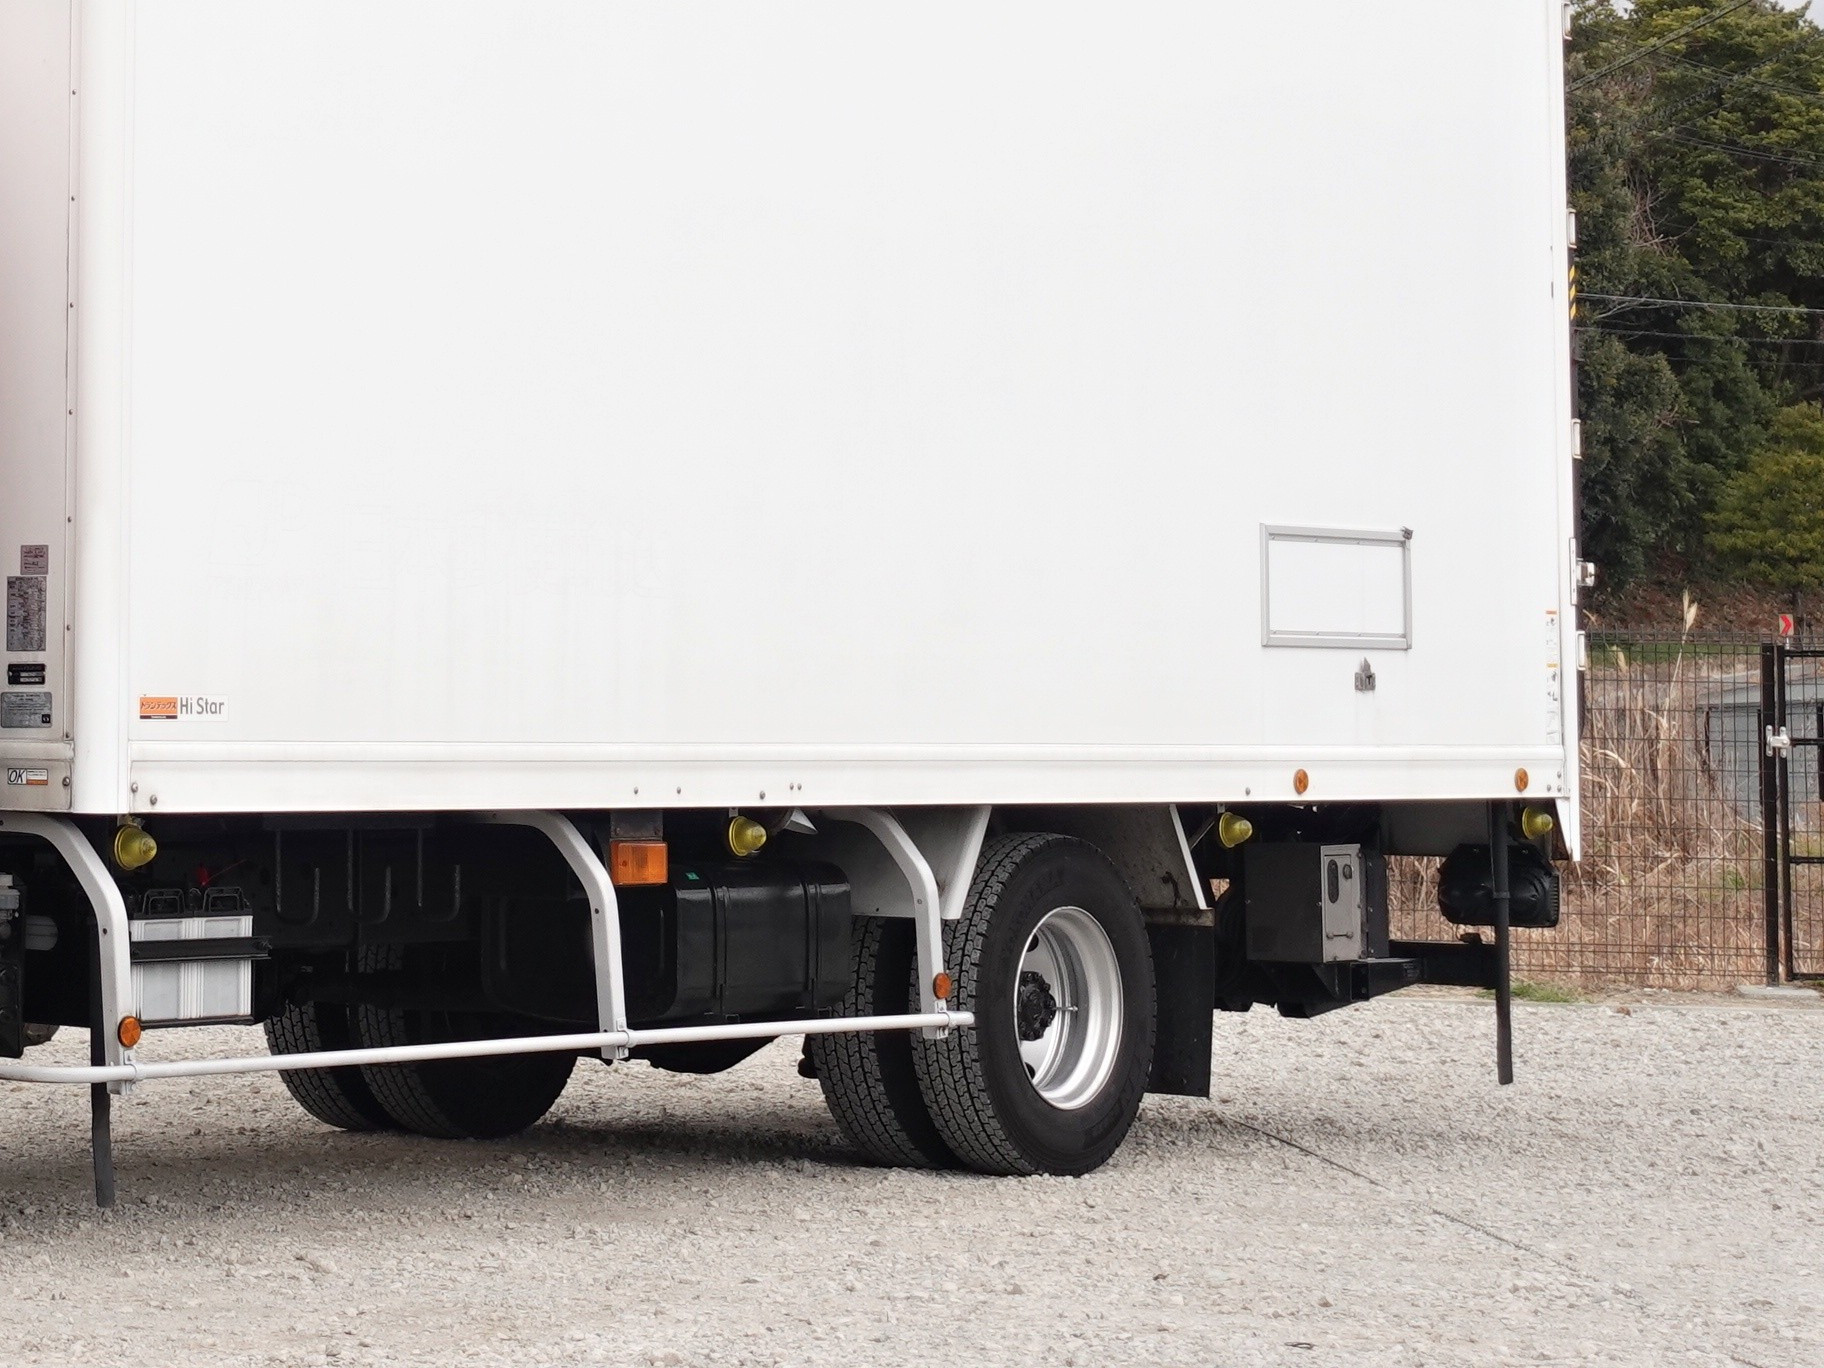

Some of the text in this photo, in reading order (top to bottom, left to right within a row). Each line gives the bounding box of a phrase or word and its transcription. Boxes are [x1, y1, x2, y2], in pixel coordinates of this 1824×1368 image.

[140, 701, 177, 710] トランテックス
[180, 697, 225, 715] Hi Star
[9, 769, 26, 783] OK
